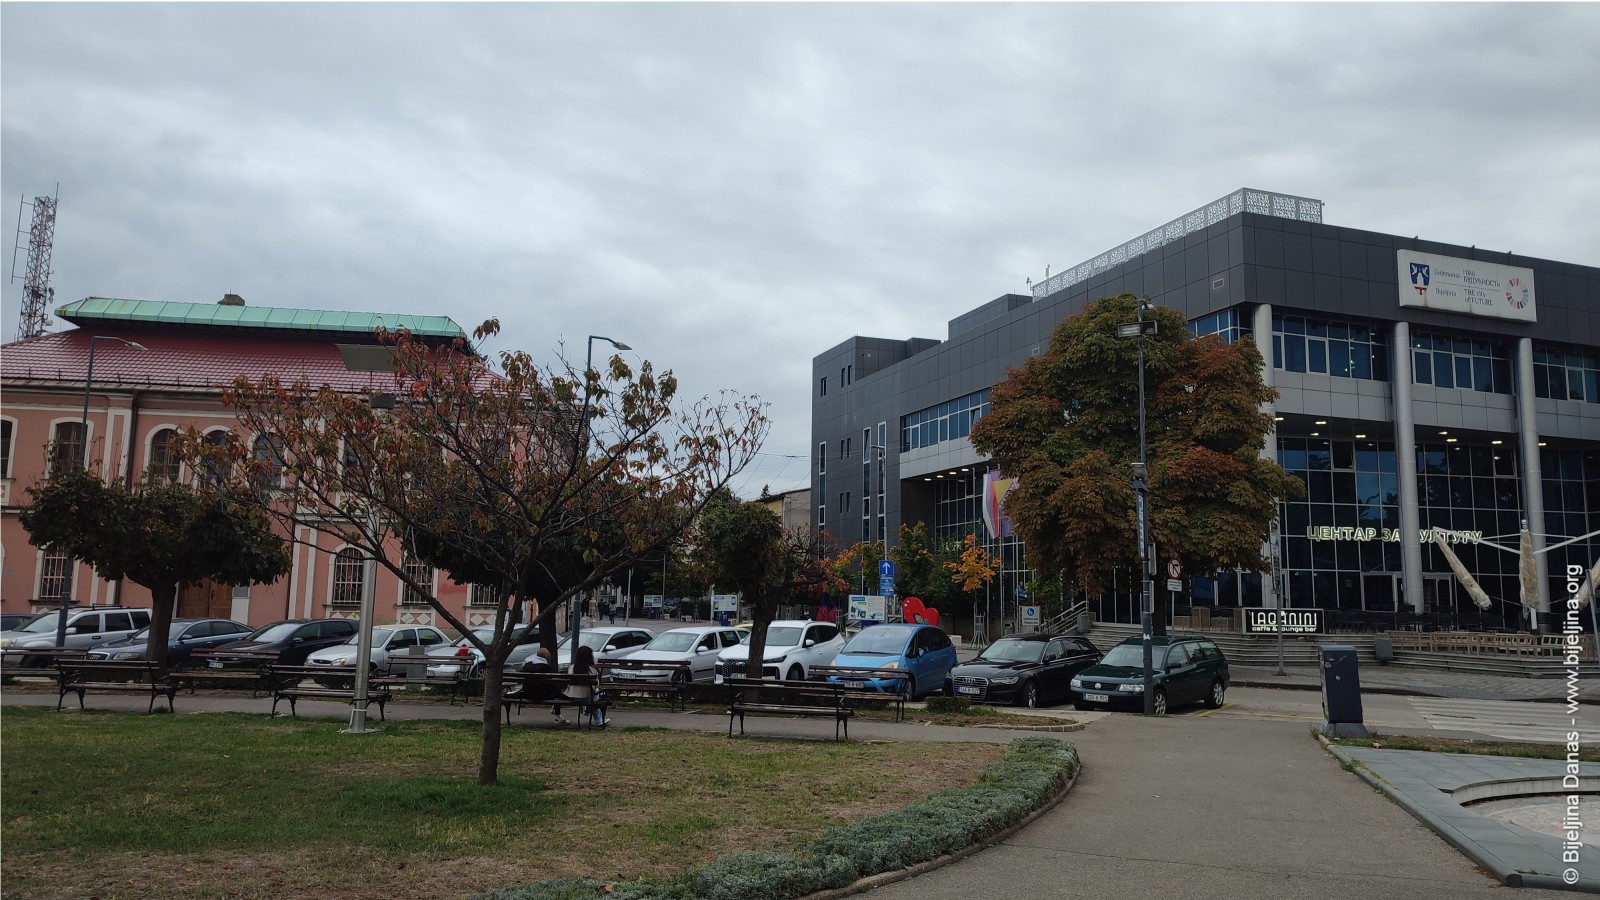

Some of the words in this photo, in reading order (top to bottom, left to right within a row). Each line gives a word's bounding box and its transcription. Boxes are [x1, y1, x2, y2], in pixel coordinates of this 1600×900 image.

[1464, 288, 1476, 296] THE
[1471, 298, 1494, 306] FUTURE
[1306, 525, 1377, 542] ЦЕНТАР
[1381, 528, 1401, 542] ЗА
[1419, 529, 1483, 544] УЛТУРУ
